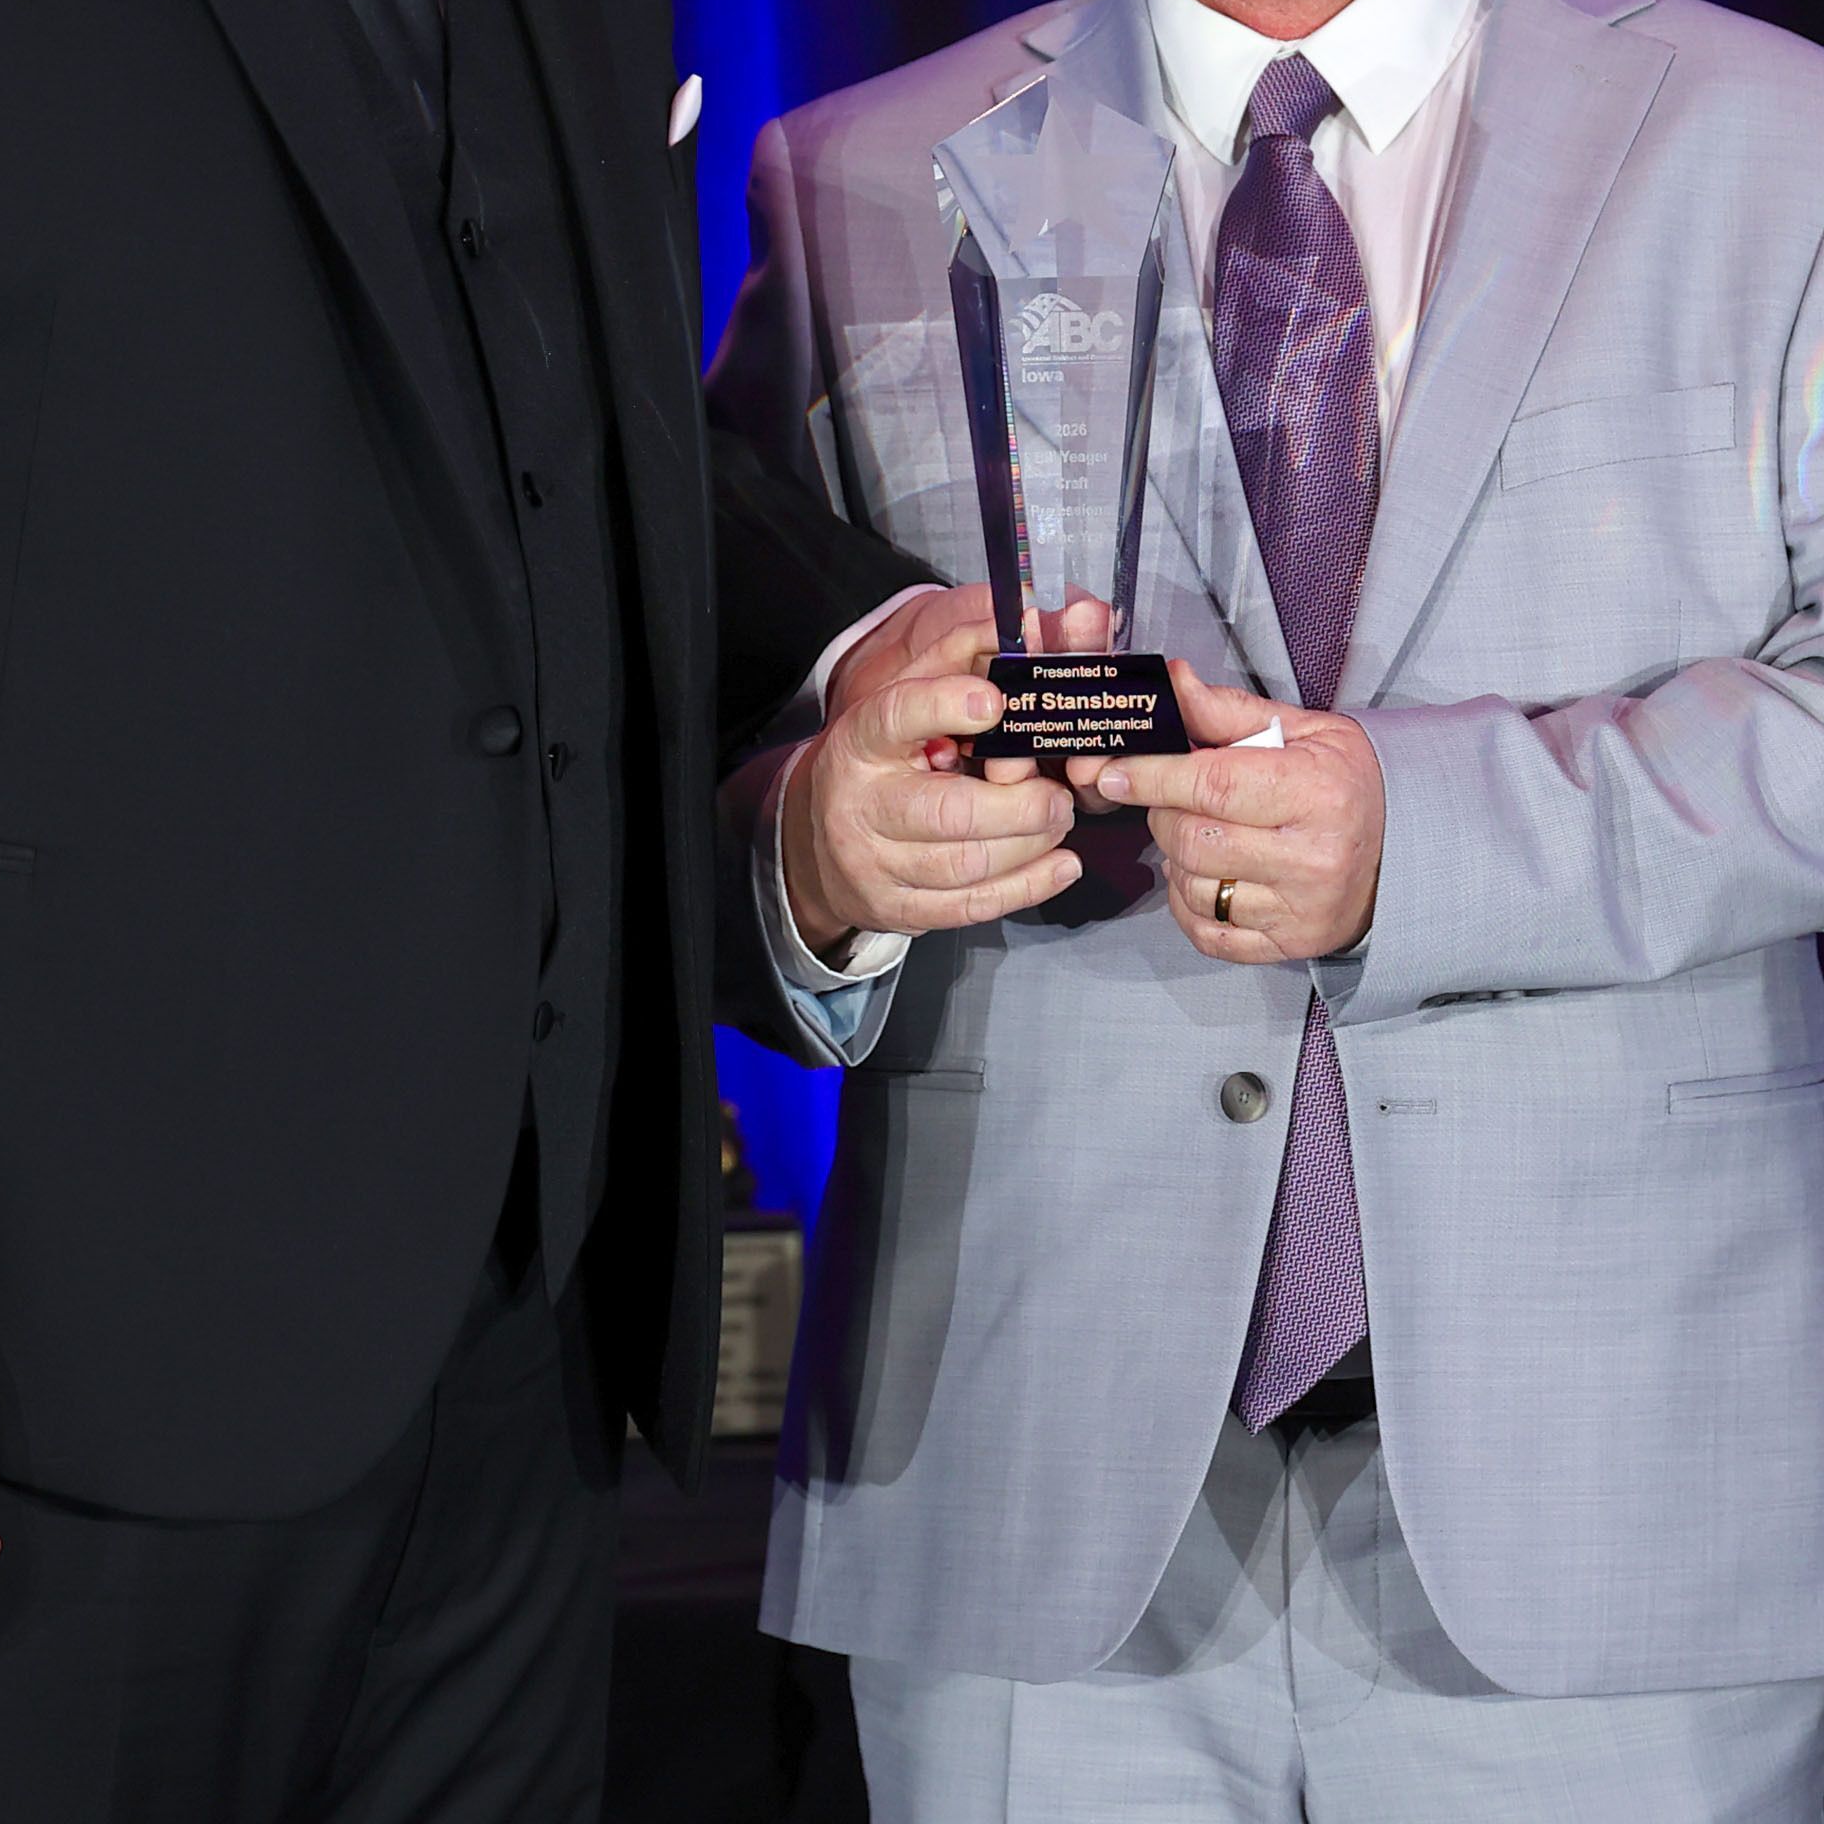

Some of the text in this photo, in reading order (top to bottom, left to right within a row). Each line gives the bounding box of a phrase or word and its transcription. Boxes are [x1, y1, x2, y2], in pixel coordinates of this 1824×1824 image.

[1022, 310, 1124, 354] ABC
[1021, 367, 1065, 384] Iowa
[1060, 449, 1108, 466] Yeager
[1033, 665, 1118, 679] Presented to
[1003, 691, 1158, 713] Jeff Stansberry
[1003, 717, 1153, 733] Hometown Mechanical
[1033, 734, 1125, 750] Davenport, IA
